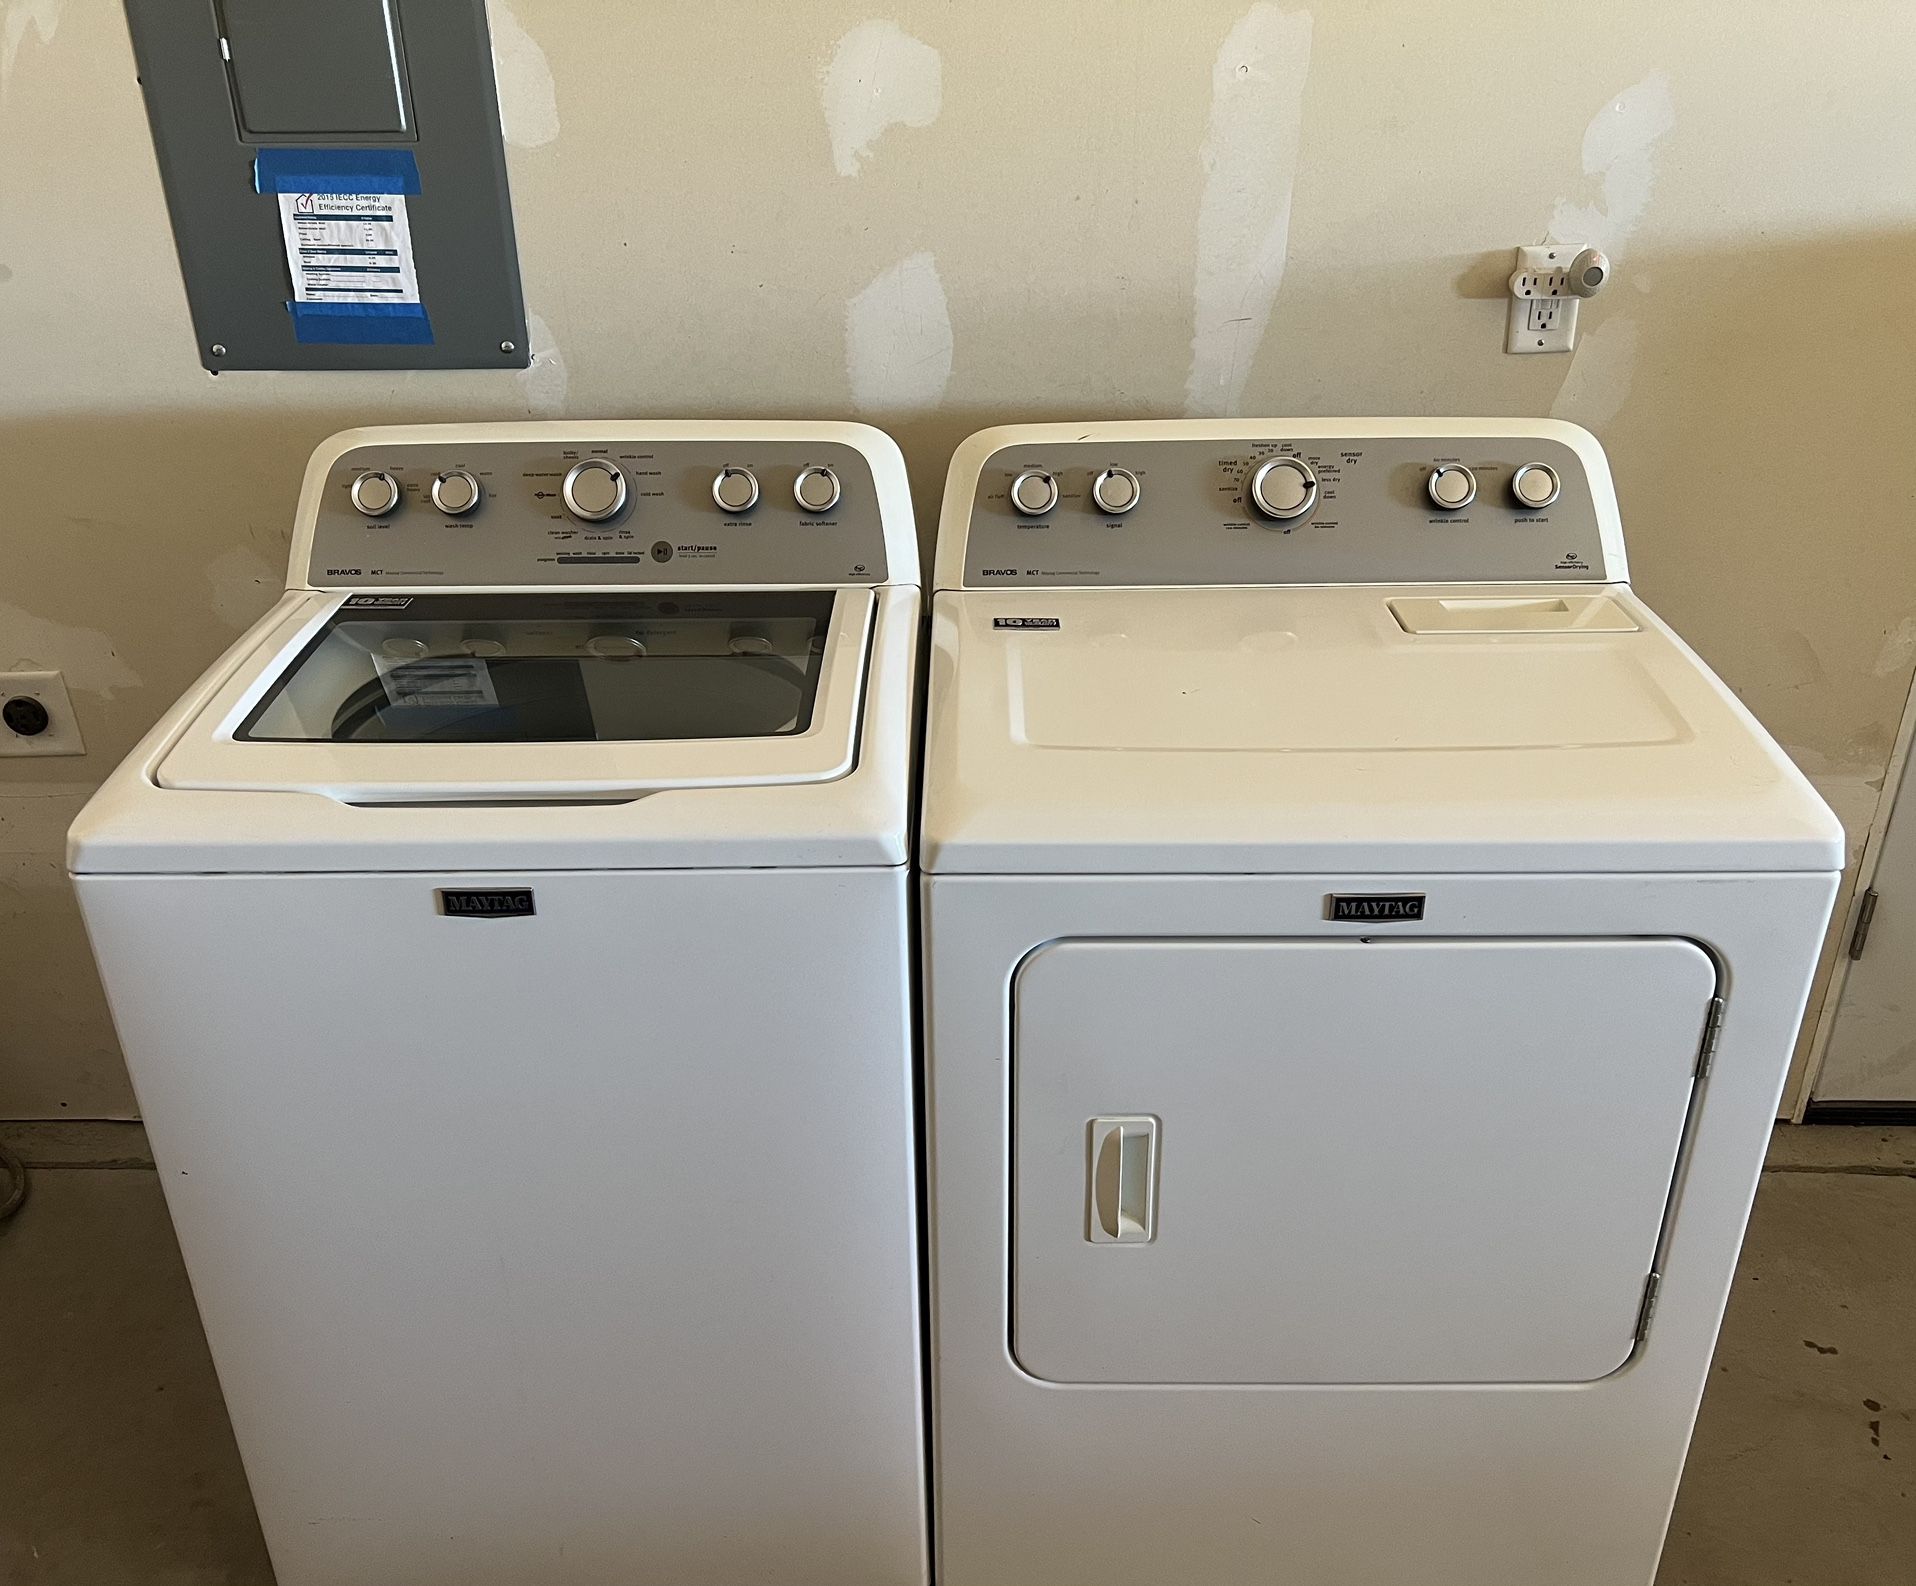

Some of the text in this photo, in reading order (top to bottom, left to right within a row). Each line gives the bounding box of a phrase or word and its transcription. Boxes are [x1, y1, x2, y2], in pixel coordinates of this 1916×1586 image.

[356, 194, 380, 203] Energy
[318, 203, 392, 212] Efficiency Certificate
[677, 544, 717, 552] start/pause
[349, 597, 375, 605] 10
[996, 618, 1023, 626] 10
[448, 895, 529, 910] MAYTAG
[1339, 901, 1418, 916] MAYTAG
